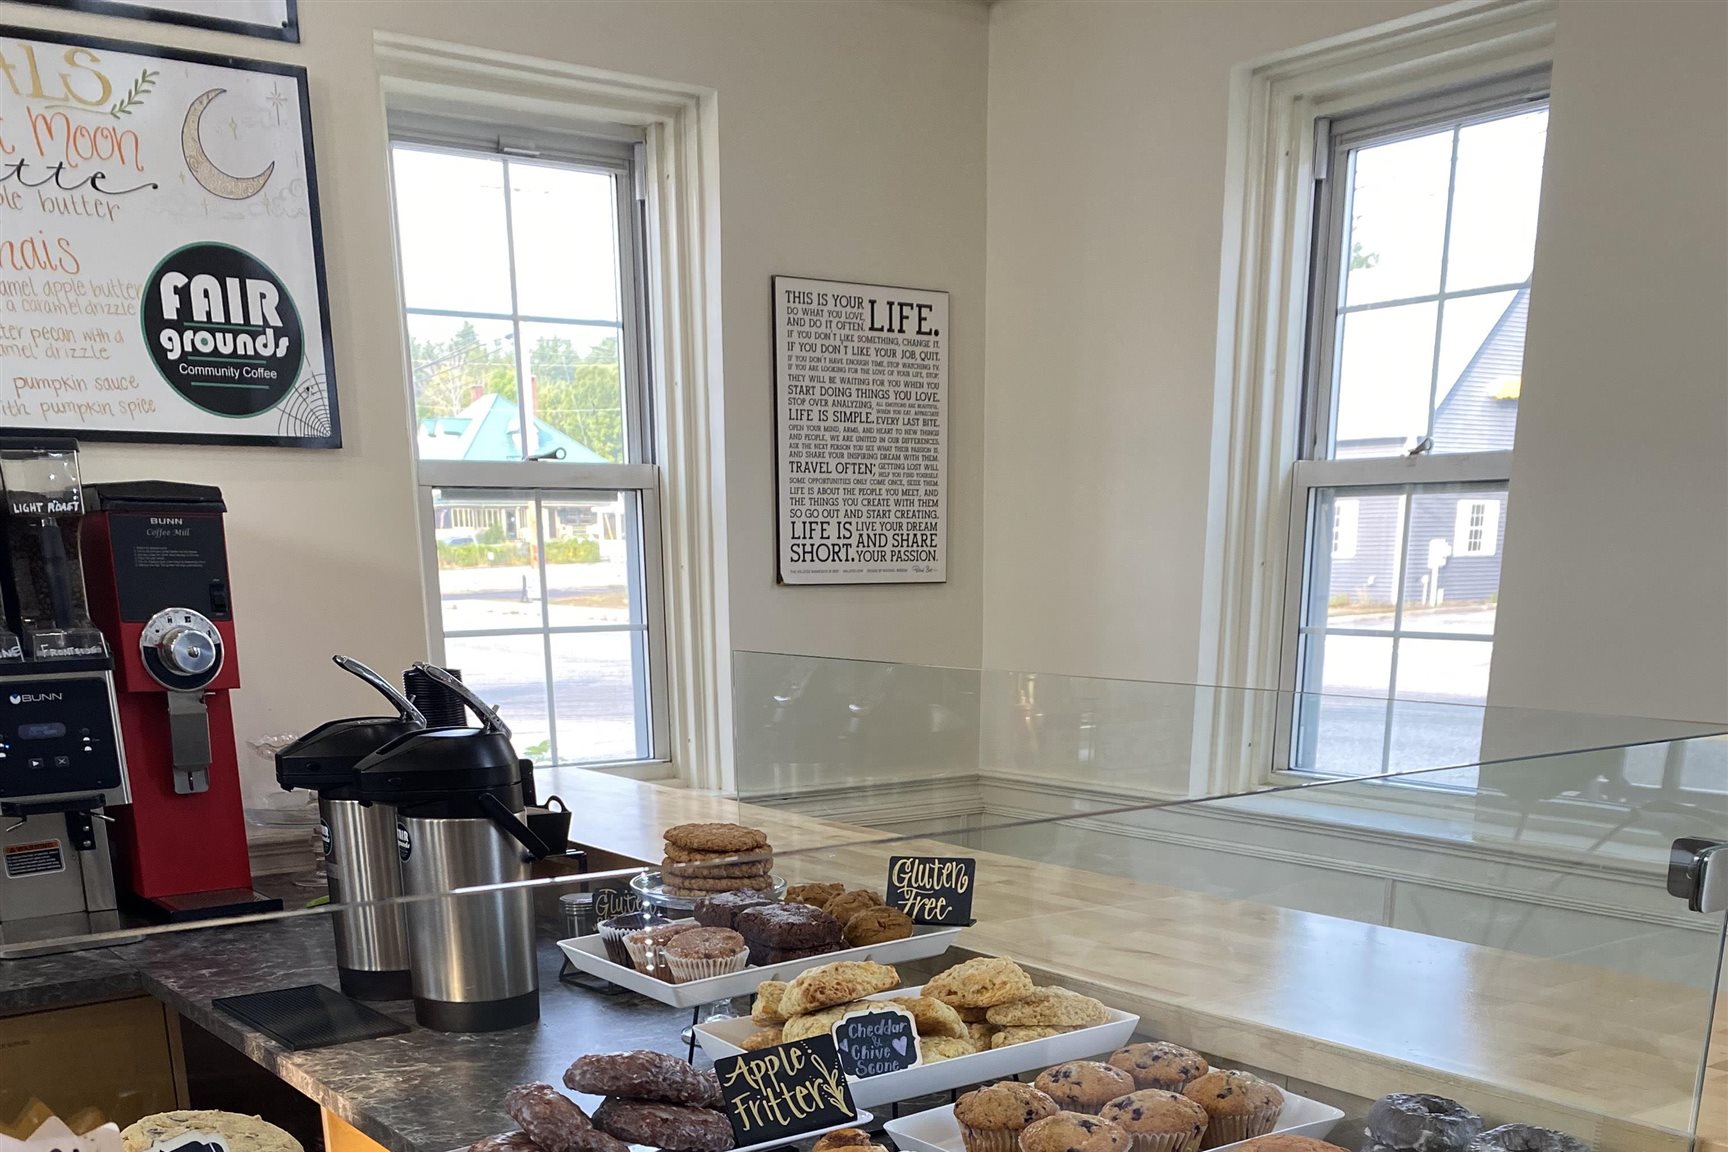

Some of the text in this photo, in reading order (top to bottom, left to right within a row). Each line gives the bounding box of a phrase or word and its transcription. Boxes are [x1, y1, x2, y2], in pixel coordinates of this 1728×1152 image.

[27, 106, 143, 171] Moon
[38, 189, 120, 221] butter
[42, 278, 86, 306] apple
[89, 278, 142, 302] butter
[160, 271, 283, 327] FAIR
[21, 297, 82, 315] caramel
[84, 299, 136, 316] drizzle
[785, 290, 940, 336] THIS IS YOUR LIFE.
[786, 305, 865, 321] DO WHAT YOU LOVE,
[786, 316, 865, 331] AND DO IT OFTEN.
[30, 326, 76, 348] pecan
[83, 328, 111, 343] with
[160, 328, 289, 361] grounds
[787, 329, 794, 338] IF
[797, 330, 812, 339] YOU
[814, 329, 837, 341] DON'T
[839, 333, 855, 342] LIKE
[857, 334, 900, 346] SOMETHING,
[902, 338, 931, 348] CHANGE
[45, 343, 112, 360] drizzle
[787, 340, 940, 362] IF YOU DON'T LIKE YOUR JOB, QUIT.
[179, 363, 278, 379] Community Coffee
[13, 375, 140, 399] pumpkin sauce
[788, 373, 939, 390] THEY WILL BE WAITING FOR YOU WHEN YOU
[787, 384, 940, 402] START DOING THINGS YOU LOVE.
[40, 401, 115, 422] pumpkin
[118, 398, 156, 420] spice
[788, 397, 874, 410] STOP OVER ANALYZING,
[788, 408, 940, 427] LIFE IS SIMPLE. EVERY LAST BITE.
[789, 460, 832, 473] TRAVEL
[835, 462, 876, 476] OFTEN;
[878, 462, 905, 470] GETTING
[924, 463, 939, 471] WILL
[789, 486, 938, 497] LIFE IS ABOUT THE PEOPLE YOU MEET, AND
[13, 500, 79, 513] LIGHT ROAST
[789, 496, 938, 507] THE THINGS YOU CREATE WITH THEM
[150, 517, 183, 525] BUNN
[789, 508, 939, 519] SO GO OUT AND START CREATING.
[146, 528, 191, 538] Coffee Mill
[790, 520, 852, 539] LIFE IS
[856, 521, 937, 531] LIVE YOUR DREAM
[856, 533, 937, 547] AND SHARE
[790, 543, 855, 562] SHORT.
[856, 549, 938, 562] YOUR PASSION.
[21, 693, 63, 702] BUNN
[892, 858, 969, 896] Gluten
[596, 888, 657, 919] Glute
[898, 889, 952, 920] Free
[848, 1019, 908, 1039] Cheddar
[871, 1036, 883, 1047] &
[851, 1045, 891, 1060] Chive
[723, 1046, 805, 1096] Apple
[855, 1060, 899, 1076] Scone
[731, 1078, 824, 1131] Fritter
